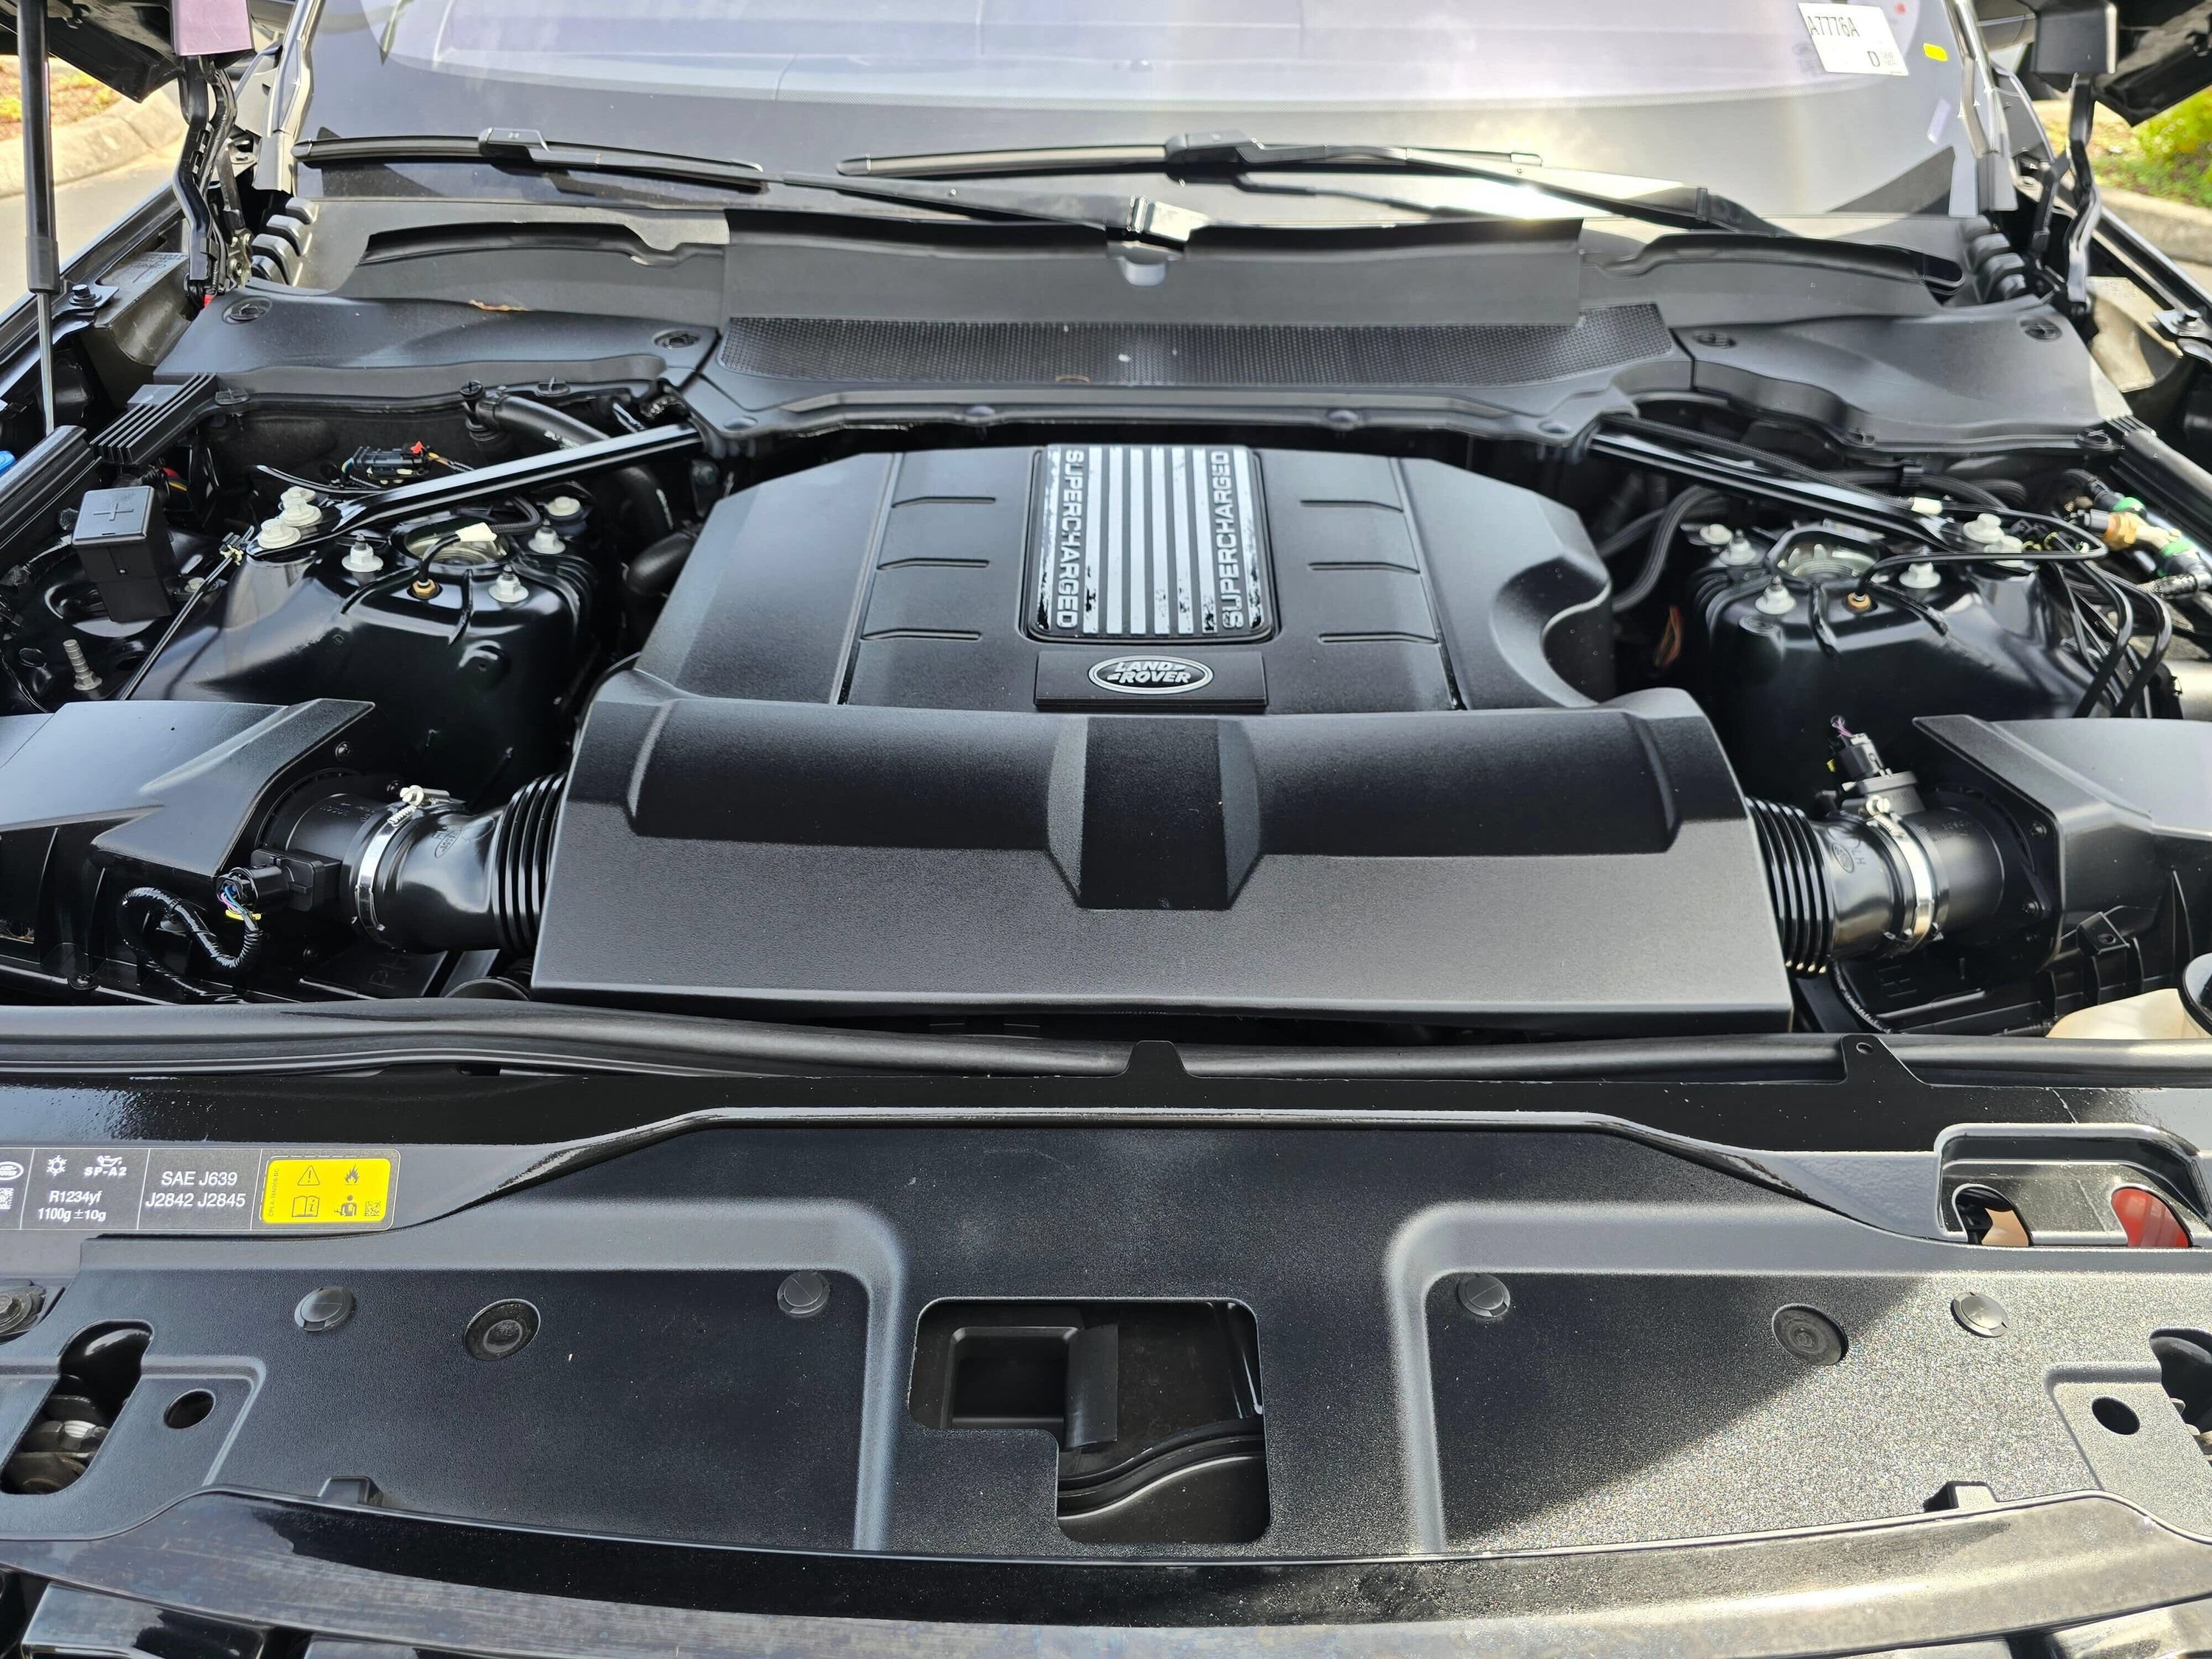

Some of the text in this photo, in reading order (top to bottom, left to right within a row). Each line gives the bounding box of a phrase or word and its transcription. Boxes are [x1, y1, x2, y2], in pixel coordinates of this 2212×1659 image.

[1807, 15, 1860, 37] A7776A
[1867, 51, 1880, 67] D
[1057, 449, 1085, 629] SUPERCHARGED
[1211, 451, 1244, 629] SUPERCHARGED
[1115, 661, 1173, 672] LAND
[1119, 671, 1192, 684] ROVER
[84, 1166, 128, 1177] SP-A2
[161, 1171, 238, 1186] SAE J639
[49, 1190, 102, 1206] R1234yf
[145, 1192, 246, 1208] J2842 J2845
[38, 1207, 72, 1222] 1100g
